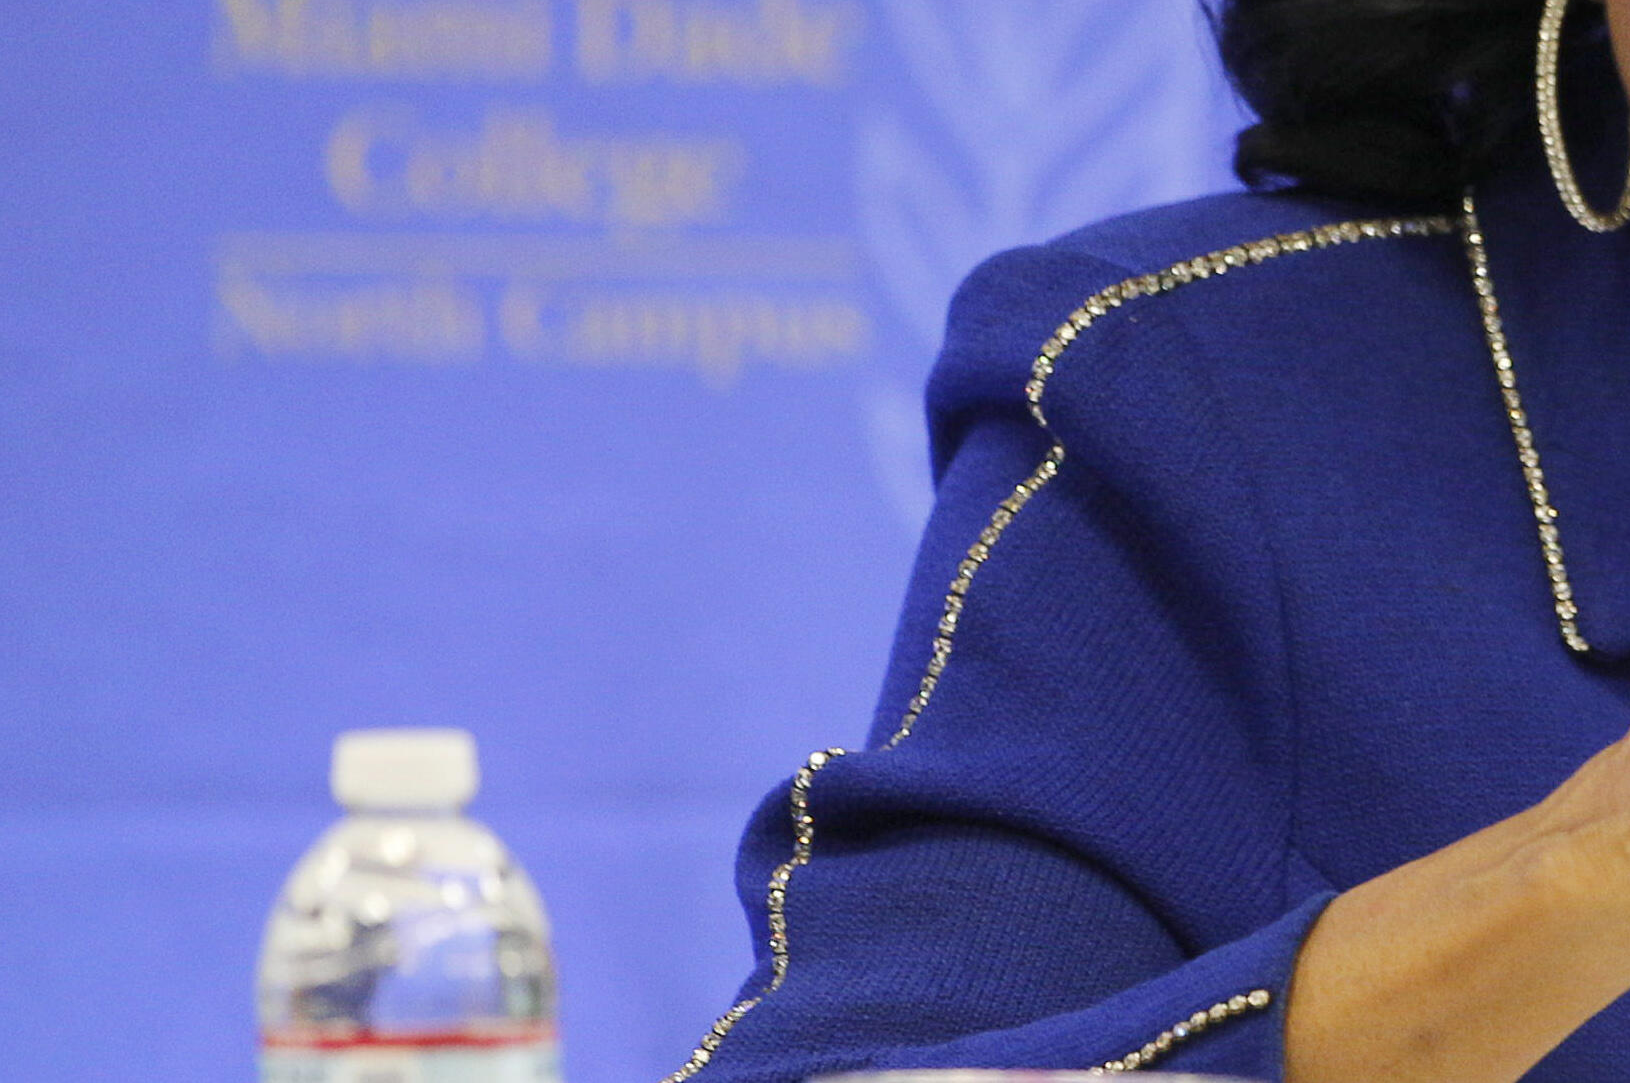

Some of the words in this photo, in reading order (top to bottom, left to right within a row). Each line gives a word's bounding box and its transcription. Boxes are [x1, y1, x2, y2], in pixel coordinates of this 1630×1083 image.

[324, 102, 744, 248] College
[212, 254, 484, 368] North
[498, 258, 870, 396] Campus
